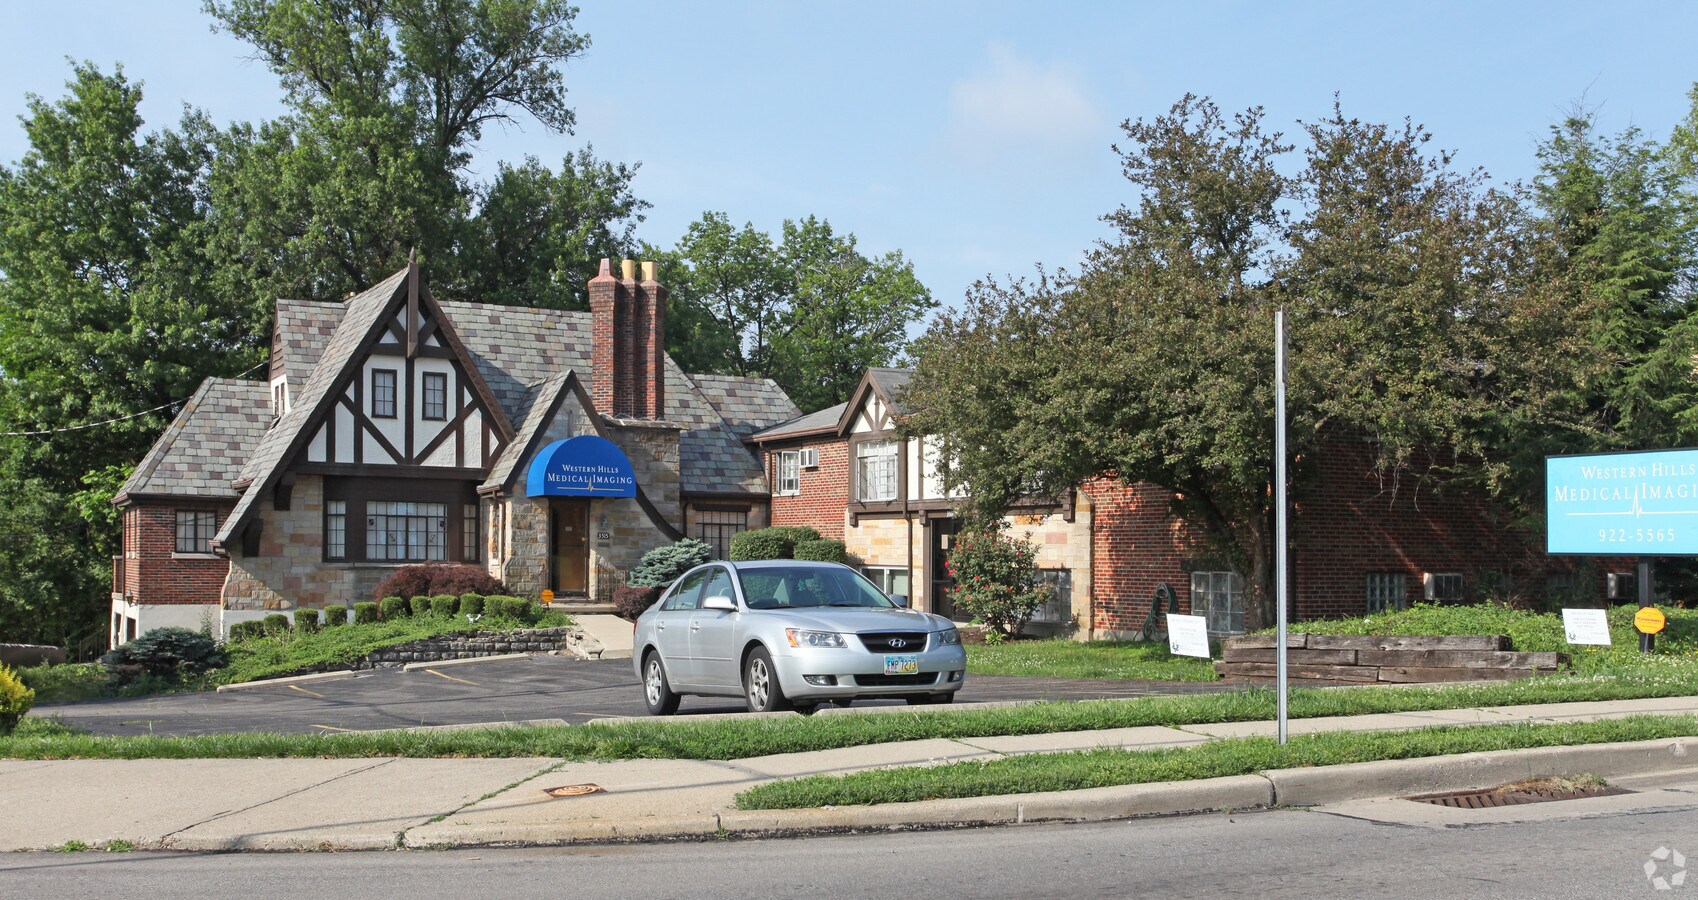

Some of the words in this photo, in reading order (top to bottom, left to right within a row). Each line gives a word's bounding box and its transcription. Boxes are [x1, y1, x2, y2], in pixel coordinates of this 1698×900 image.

[562, 464, 596, 473] WESTERN
[597, 465, 619, 474] HILLS
[1581, 465, 1647, 480] WESTERN
[1652, 462, 1696, 477] HILLS
[548, 473, 589, 483] MEDICAL
[592, 475, 633, 485] IMAGING
[1555, 485, 1632, 502] MEDICAL
[1599, 528, 1675, 542] 922-5565
